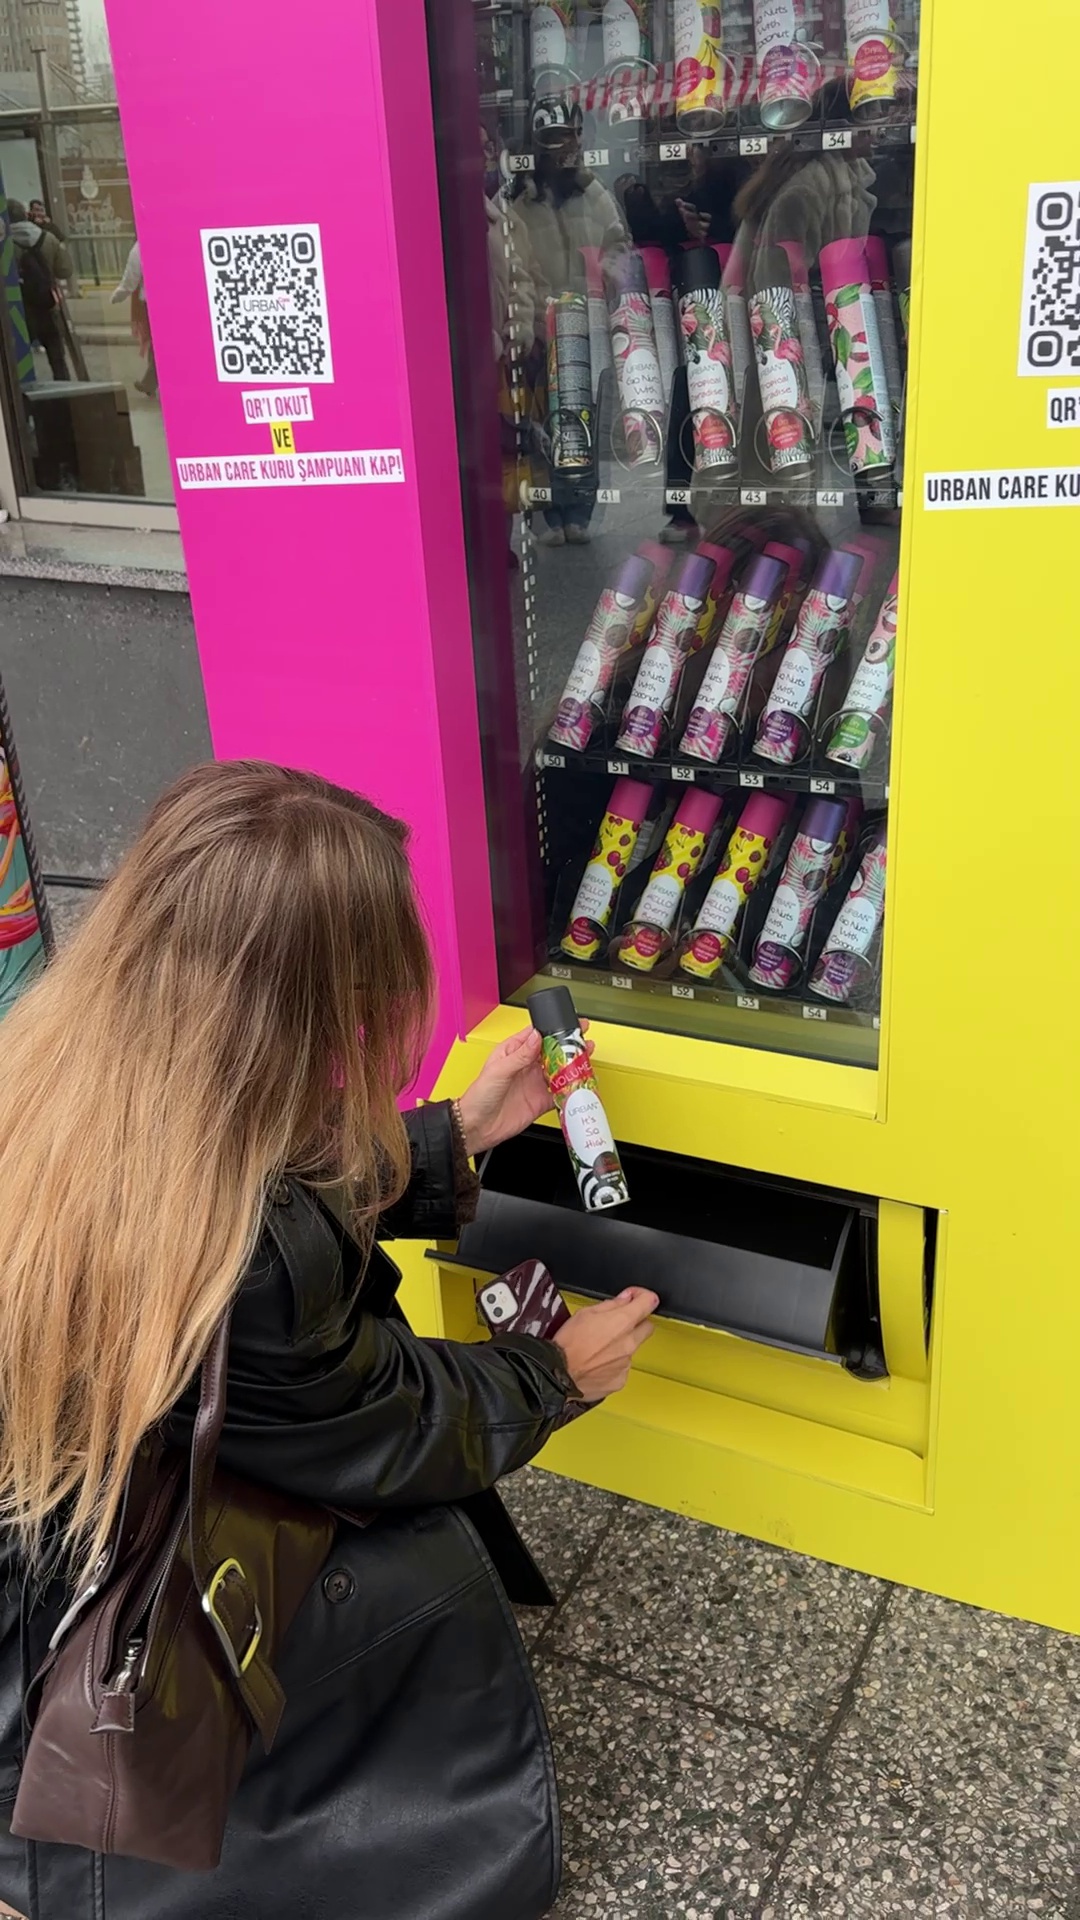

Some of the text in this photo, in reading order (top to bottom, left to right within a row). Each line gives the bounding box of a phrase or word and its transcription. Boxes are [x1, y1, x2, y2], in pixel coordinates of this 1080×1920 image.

[745, 138, 762, 153] 33
[828, 133, 845, 147] 34
[515, 157, 530, 169] 30
[589, 151, 602, 164] 31
[243, 299, 286, 312] URBAN
[245, 394, 309, 420] QR'I OKUT
[273, 428, 292, 448] VE
[179, 455, 402, 483] URBAN CARE KURU ŞAMPUANI KAP!
[532, 488, 547, 500] 40
[927, 477, 991, 502] URBAN
[998, 475, 1049, 499] CARE
[601, 490, 614, 501] 41
[745, 492, 761, 503] 43
[821, 492, 838, 504] 44
[548, 756, 561, 767] 50
[612, 762, 625, 772] 51
[745, 774, 759, 785] 53
[815, 780, 830, 792] 54
[850, 921, 869, 934] Nuts
[615, 977, 629, 987] 51
[807, 1007, 822, 1018] 54
[551, 1061, 592, 1089] VOLUME
[568, 1103, 598, 1117] URBAN
[581, 1115, 597, 1126] It's
[585, 1127, 600, 1137] So
